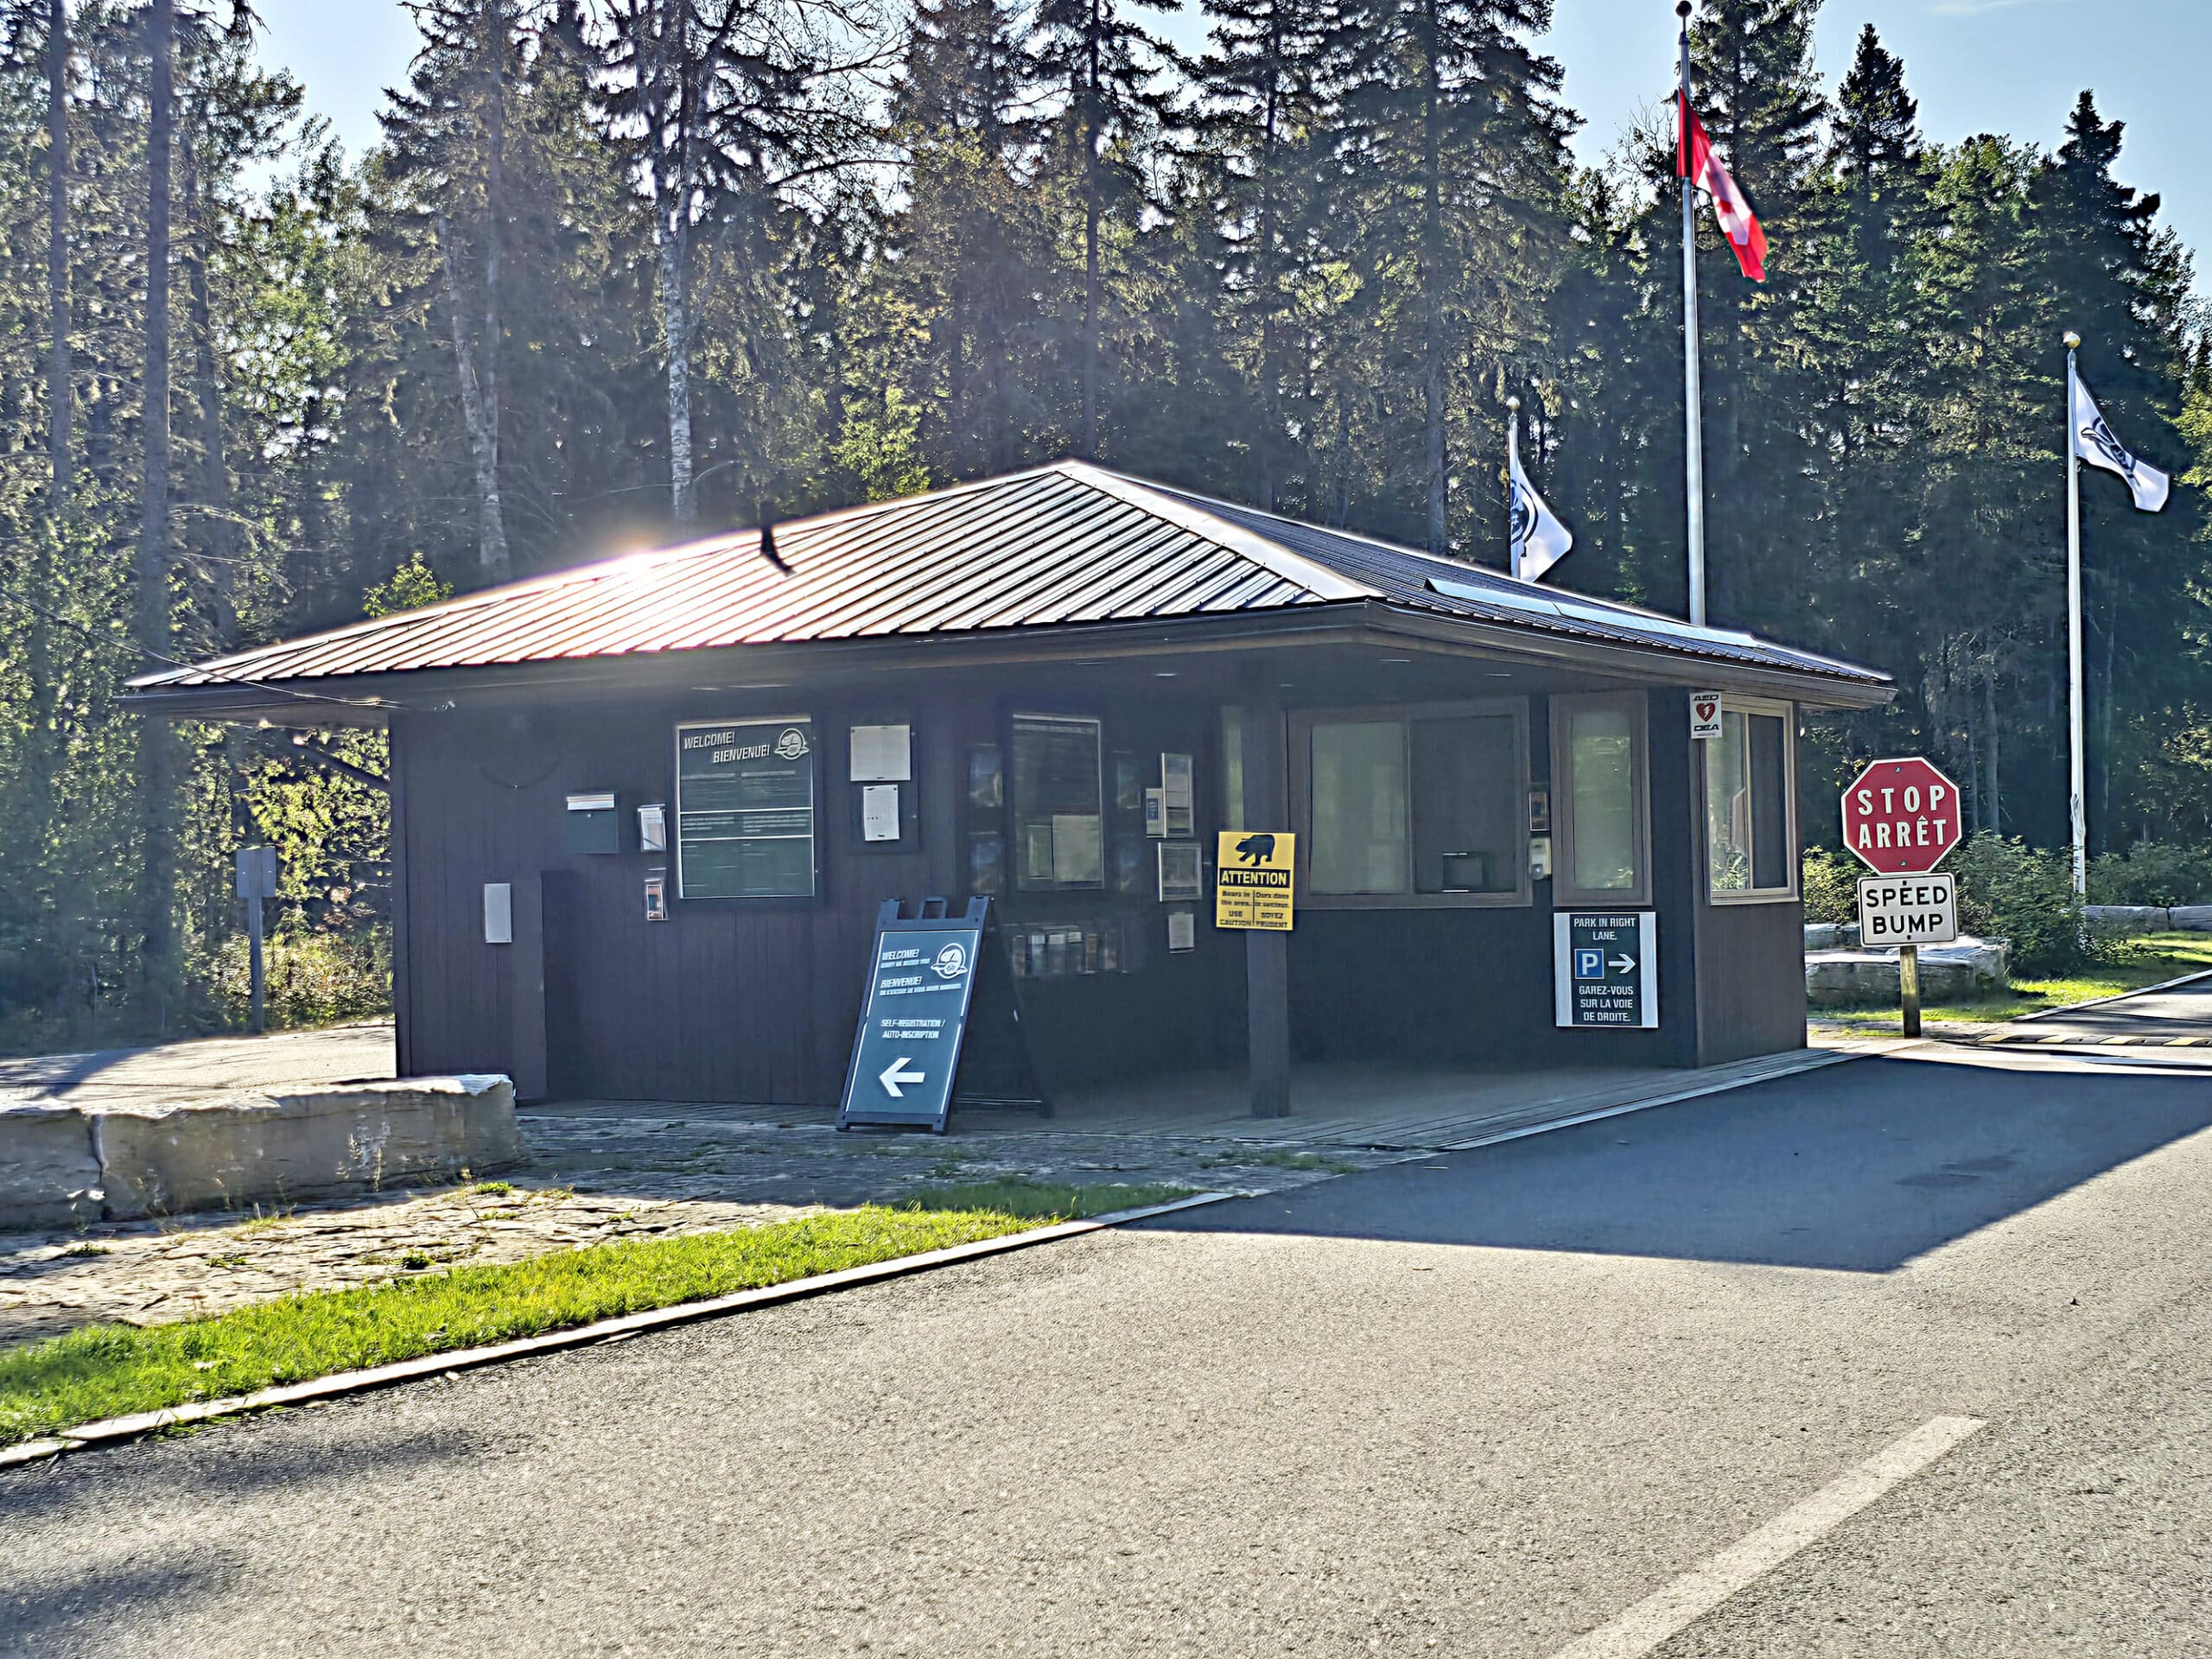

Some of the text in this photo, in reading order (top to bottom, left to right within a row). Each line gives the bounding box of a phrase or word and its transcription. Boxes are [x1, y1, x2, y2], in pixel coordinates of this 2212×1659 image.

[683, 731, 735, 750] WELCOME!
[712, 744, 771, 764] BIENVENUE!
[1857, 785, 1945, 816] STOP
[1858, 815, 1947, 849] ARRÊT
[1221, 870, 1287, 886] ATTENTION
[1866, 886, 1948, 907] SPEED
[1573, 918, 1636, 927] PARK IN RIGHT
[1872, 913, 1943, 935] BUMP
[1581, 953, 1599, 976] P
[1579, 985, 1634, 995] GAREZ-VOUS
[1580, 999, 1633, 1008] SUR LA VOIE
[1583, 1012, 1595, 1021] DE
